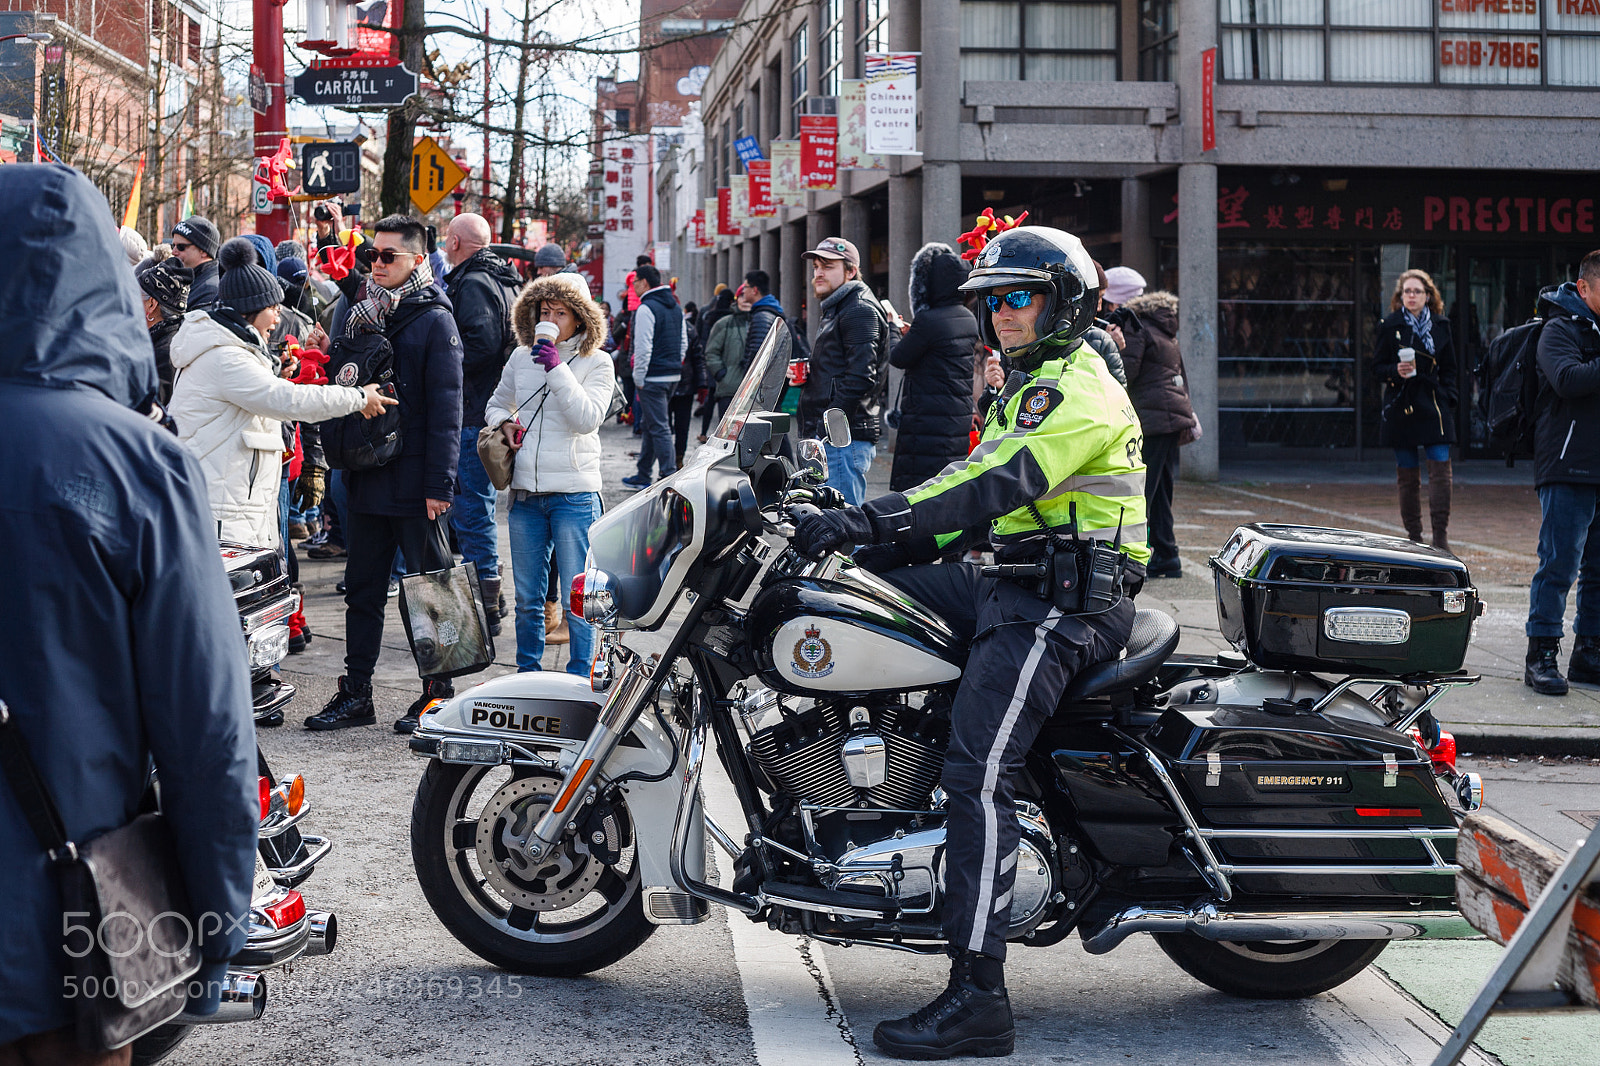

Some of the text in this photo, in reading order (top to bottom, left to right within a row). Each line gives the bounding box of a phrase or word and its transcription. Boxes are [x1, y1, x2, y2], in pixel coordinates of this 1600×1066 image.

[314, 79, 394, 96] CARRALL ST
[346, 94, 362, 103] 500
[870, 92, 912, 101] Chinese
[870, 106, 913, 114] Cultural
[874, 119, 909, 128] Centre
[809, 135, 834, 146] Kung
[816, 147, 834, 158] Hey
[818, 160, 834, 169] Fat
[809, 172, 834, 182] Choy
[1424, 196, 1594, 233] PRESTIGE
[1019, 412, 1043, 421] POLICE
[473, 701, 515, 711] VANCOUVER
[471, 708, 561, 735] POLICE
[1257, 776, 1343, 785] EMERGENCY 911
